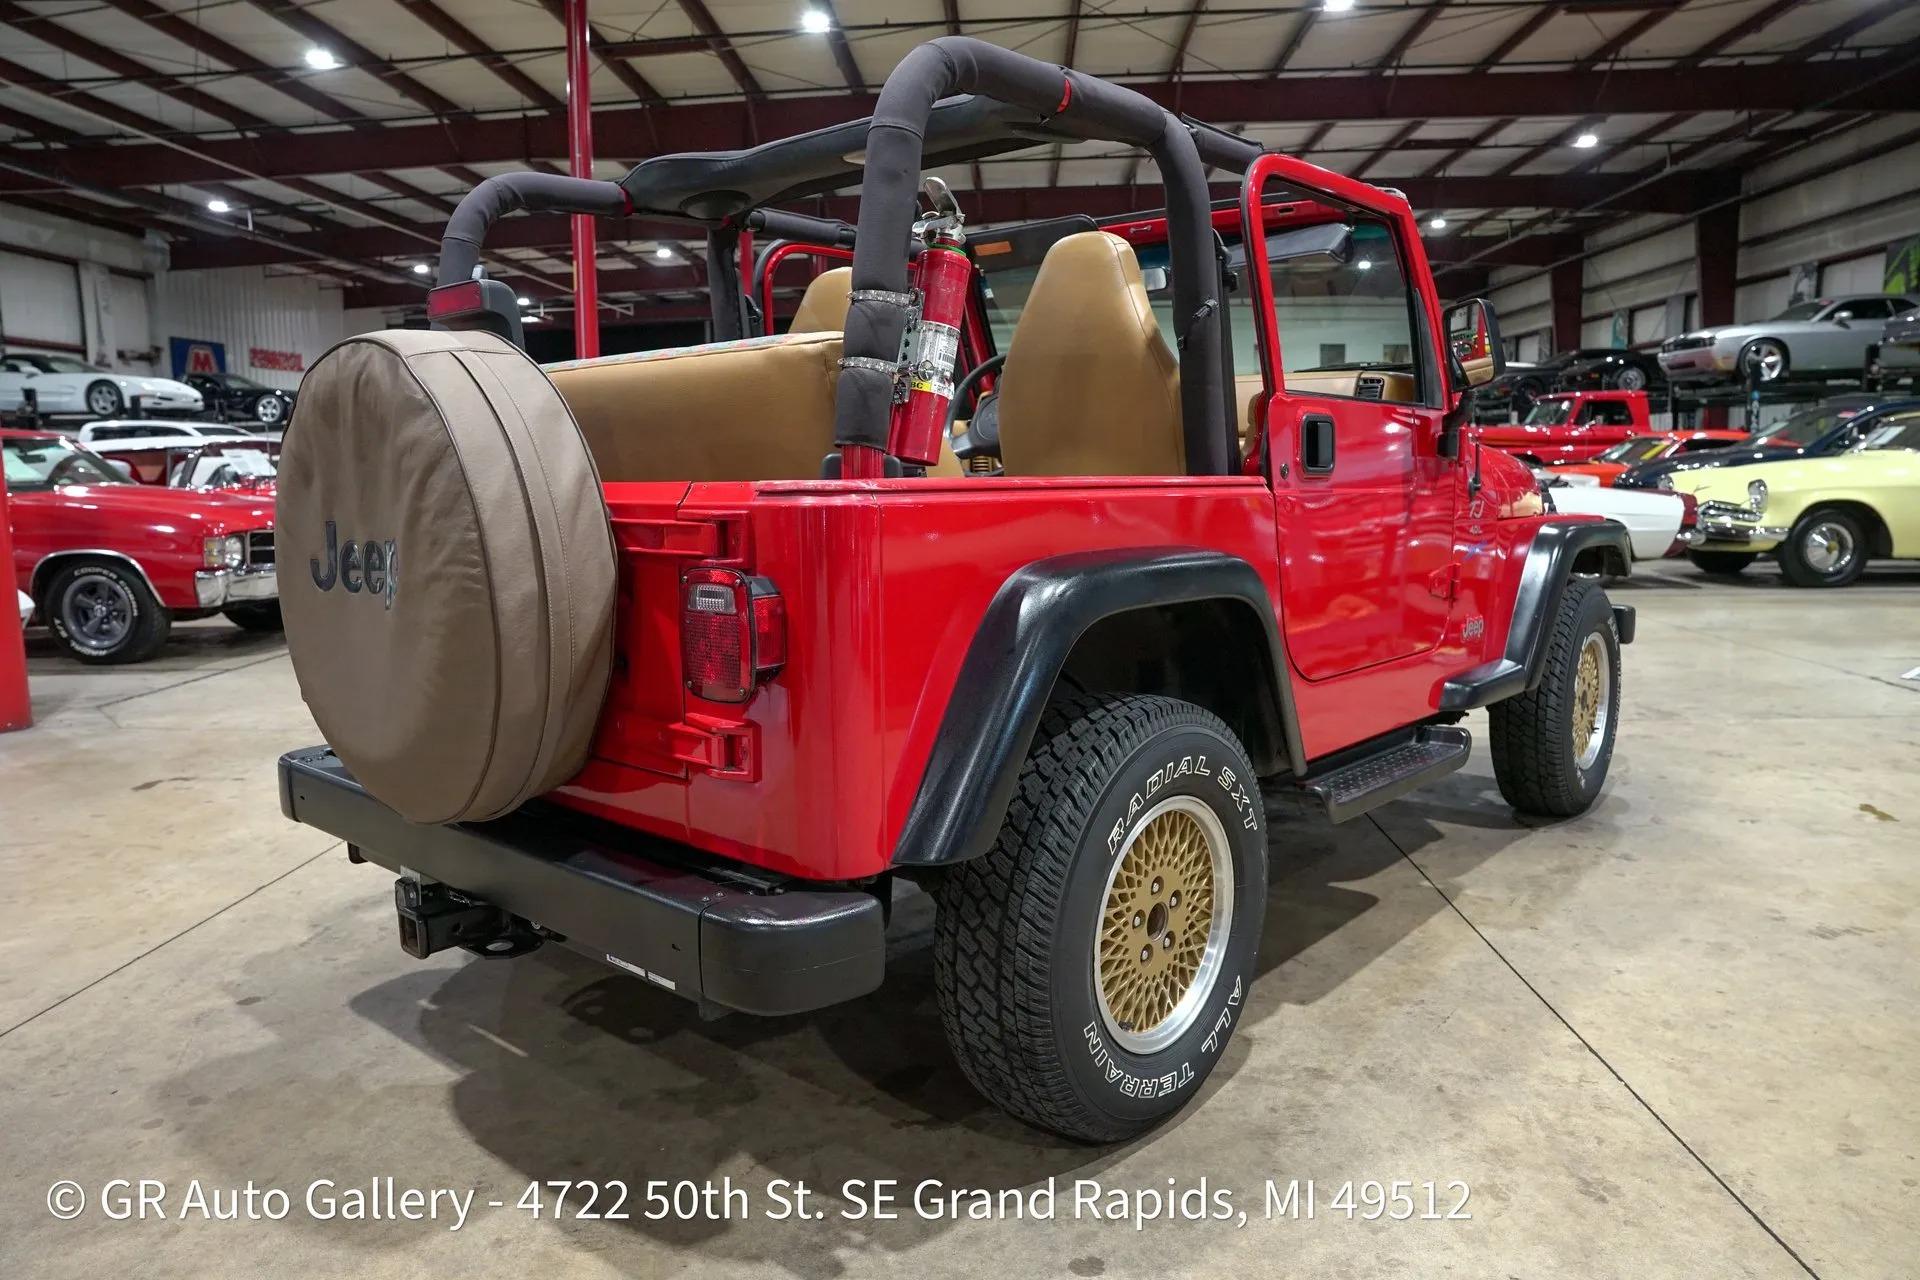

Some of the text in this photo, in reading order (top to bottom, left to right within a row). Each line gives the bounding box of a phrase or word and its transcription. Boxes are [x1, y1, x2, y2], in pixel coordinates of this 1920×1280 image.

[191, 350, 214, 374] M
[73, 566, 118, 580] COOPER
[309, 520, 397, 610] Jeep
[1461, 617, 1484, 641] Jeep
[1107, 756, 1258, 856] RADIAL SXT
[1083, 975, 1242, 1100] ALL TERRAIN
